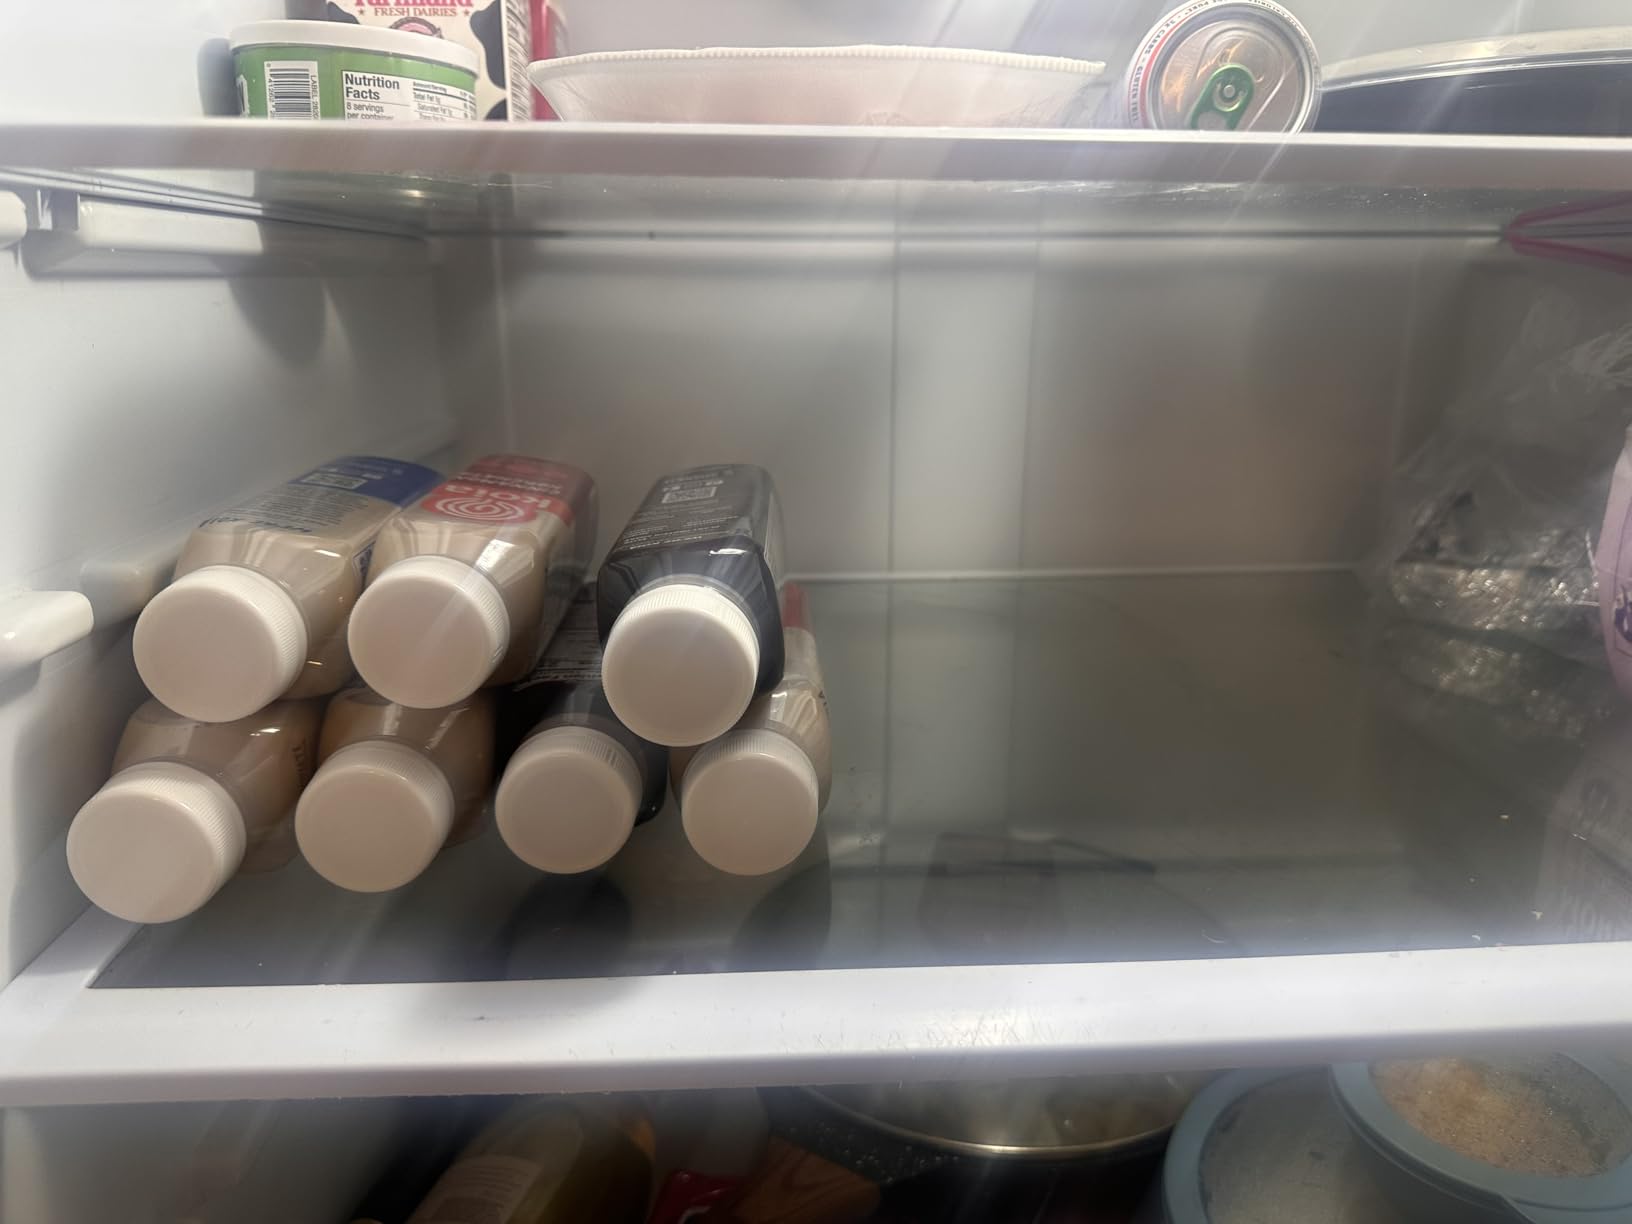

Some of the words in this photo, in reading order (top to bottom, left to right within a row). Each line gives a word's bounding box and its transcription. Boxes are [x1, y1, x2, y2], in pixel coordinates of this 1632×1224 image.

[374, 7, 409, 16] FRESH
[413, 7, 457, 17] DAIRIES
[310, 74, 318, 99] LABEL
[345, 73, 400, 90] Nutrition
[345, 86, 380, 100] Facts
[346, 102, 352, 110] 8
[353, 103, 384, 113] servings
[347, 112, 358, 120] per
